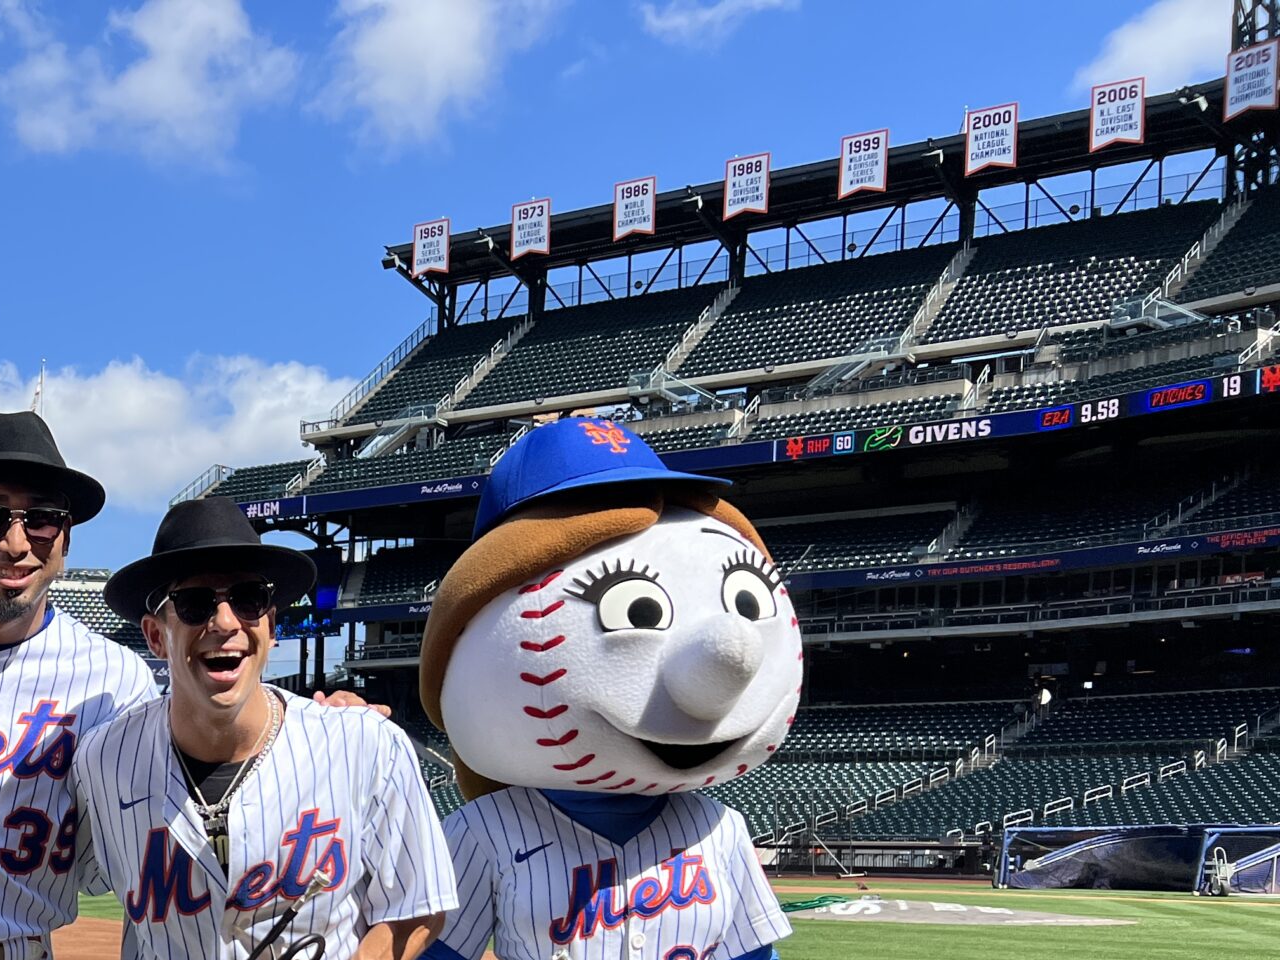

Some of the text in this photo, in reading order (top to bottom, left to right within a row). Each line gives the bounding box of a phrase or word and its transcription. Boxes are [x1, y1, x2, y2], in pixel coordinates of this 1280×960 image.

[1234, 48, 1271, 72] 2015
[1234, 71, 1271, 85] NATIONAL
[1236, 78, 1267, 94] LEAGUE
[1097, 84, 1138, 105] 2006
[1230, 86, 1273, 105] CHAMPIONS
[1116, 103, 1136, 114] EAST
[972, 110, 1012, 130] 2000
[1101, 114, 1133, 126] DIVISION
[974, 128, 1009, 142] NATIONAL
[1095, 123, 1139, 137] CHAMPIONS
[848, 137, 880, 154] 1999
[977, 138, 1005, 150] LEAGUE
[849, 152, 878, 164] WILD CARD
[970, 146, 1012, 161] CHAMPIONS
[732, 160, 762, 177] 1988
[852, 160, 879, 171] DIVISION
[852, 168, 874, 177] SERIES
[745, 177, 762, 186] EAST
[849, 175, 876, 186] WINNERS
[621, 183, 649, 200] 1986
[733, 187, 760, 198] DIVISION
[624, 200, 645, 210] WORLD
[728, 194, 764, 206] CHAMPIONS
[518, 205, 544, 221] 1973
[624, 208, 645, 218] SERIES
[518, 221, 543, 231] NATIONAL
[618, 216, 651, 228] CHAMPIONS
[420, 224, 444, 240] 1969
[519, 229, 542, 239] LEAGUE
[422, 240, 440, 249] WORLD
[515, 236, 546, 248] CHAMPIONS
[421, 249, 440, 257] SERIES
[416, 256, 445, 266] CHAMPIONS
[1151, 385, 1206, 407] PITCHES
[1222, 375, 1241, 397] 19
[1042, 398, 1120, 427] ERA 9.58
[807, 438, 830, 454] RHP
[835, 436, 852, 451] 60
[908, 419, 992, 444] GIVENS
[246, 501, 280, 518] #LGM
[549, 848, 716, 946] Mets
